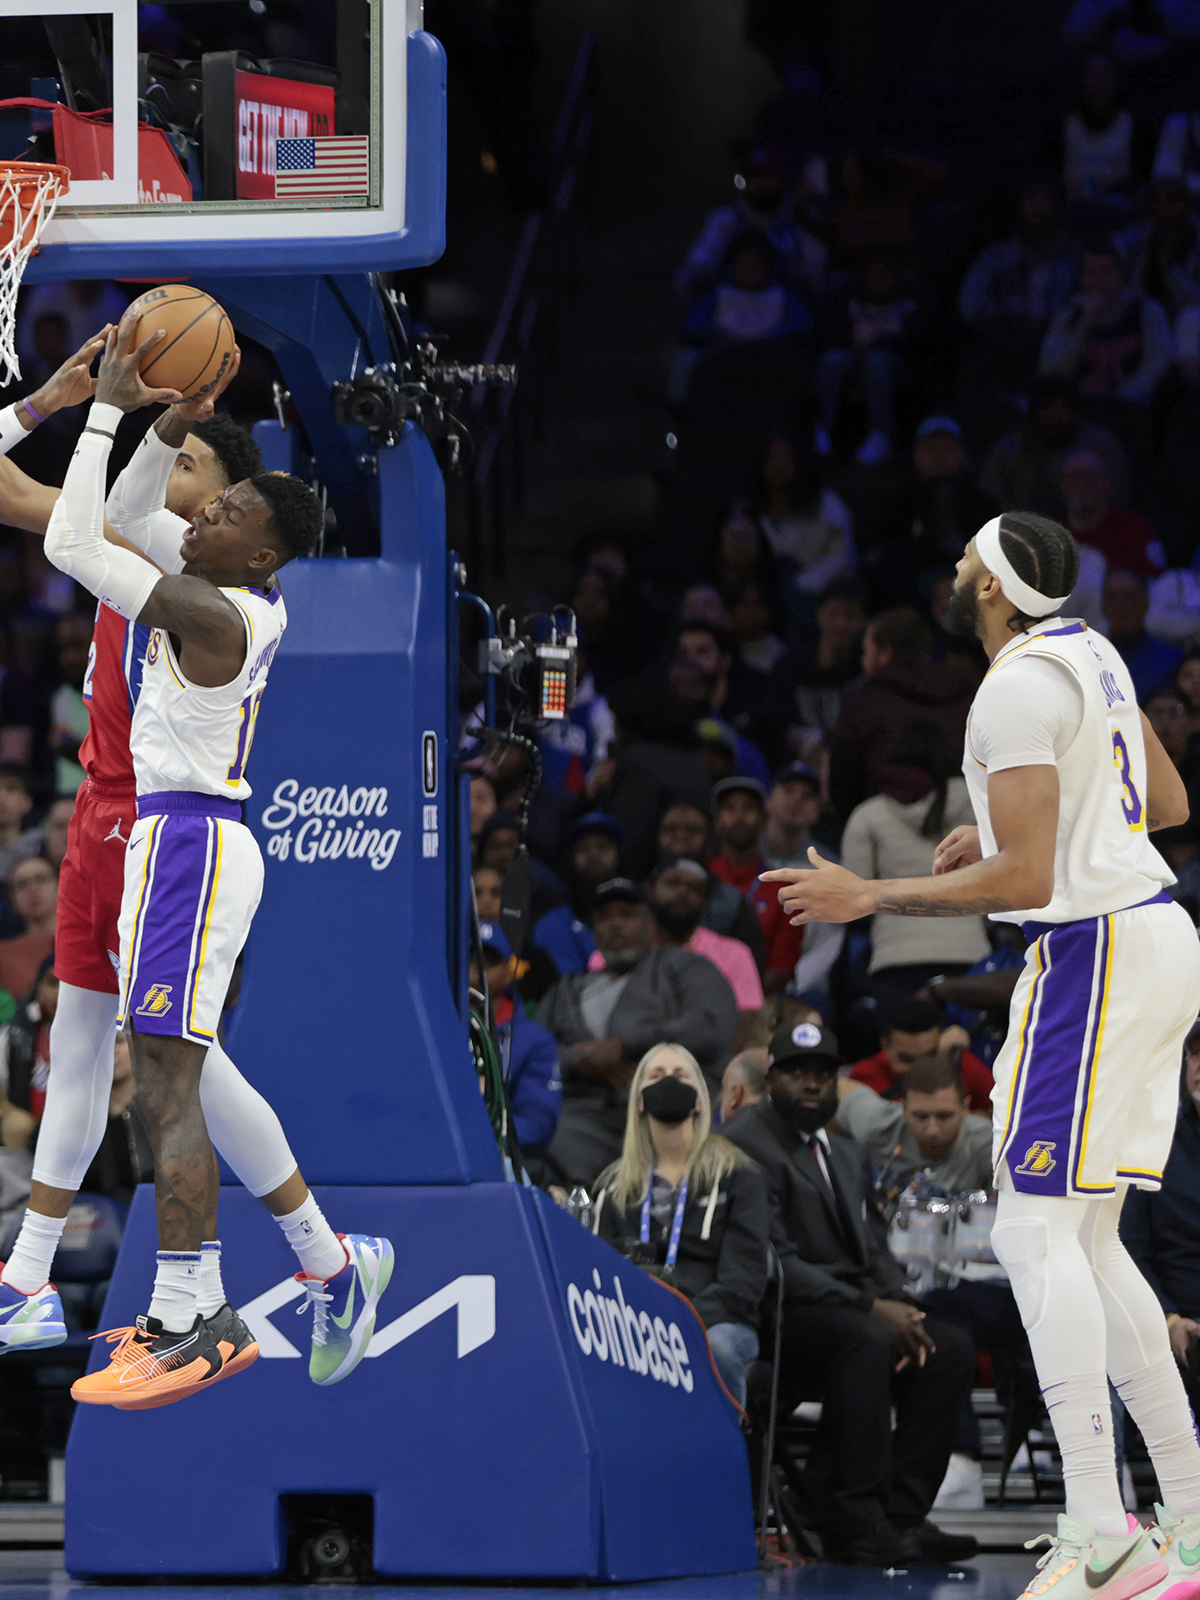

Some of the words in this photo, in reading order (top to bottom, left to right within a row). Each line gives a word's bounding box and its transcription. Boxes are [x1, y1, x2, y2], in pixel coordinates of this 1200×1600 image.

[238, 98, 260, 173] GET
[262, 778, 389, 830] Season
[1112, 727, 1147, 834] 3
[266, 829, 294, 862] of
[293, 817, 402, 871] Giving
[566, 1267, 694, 1394] coinbase
